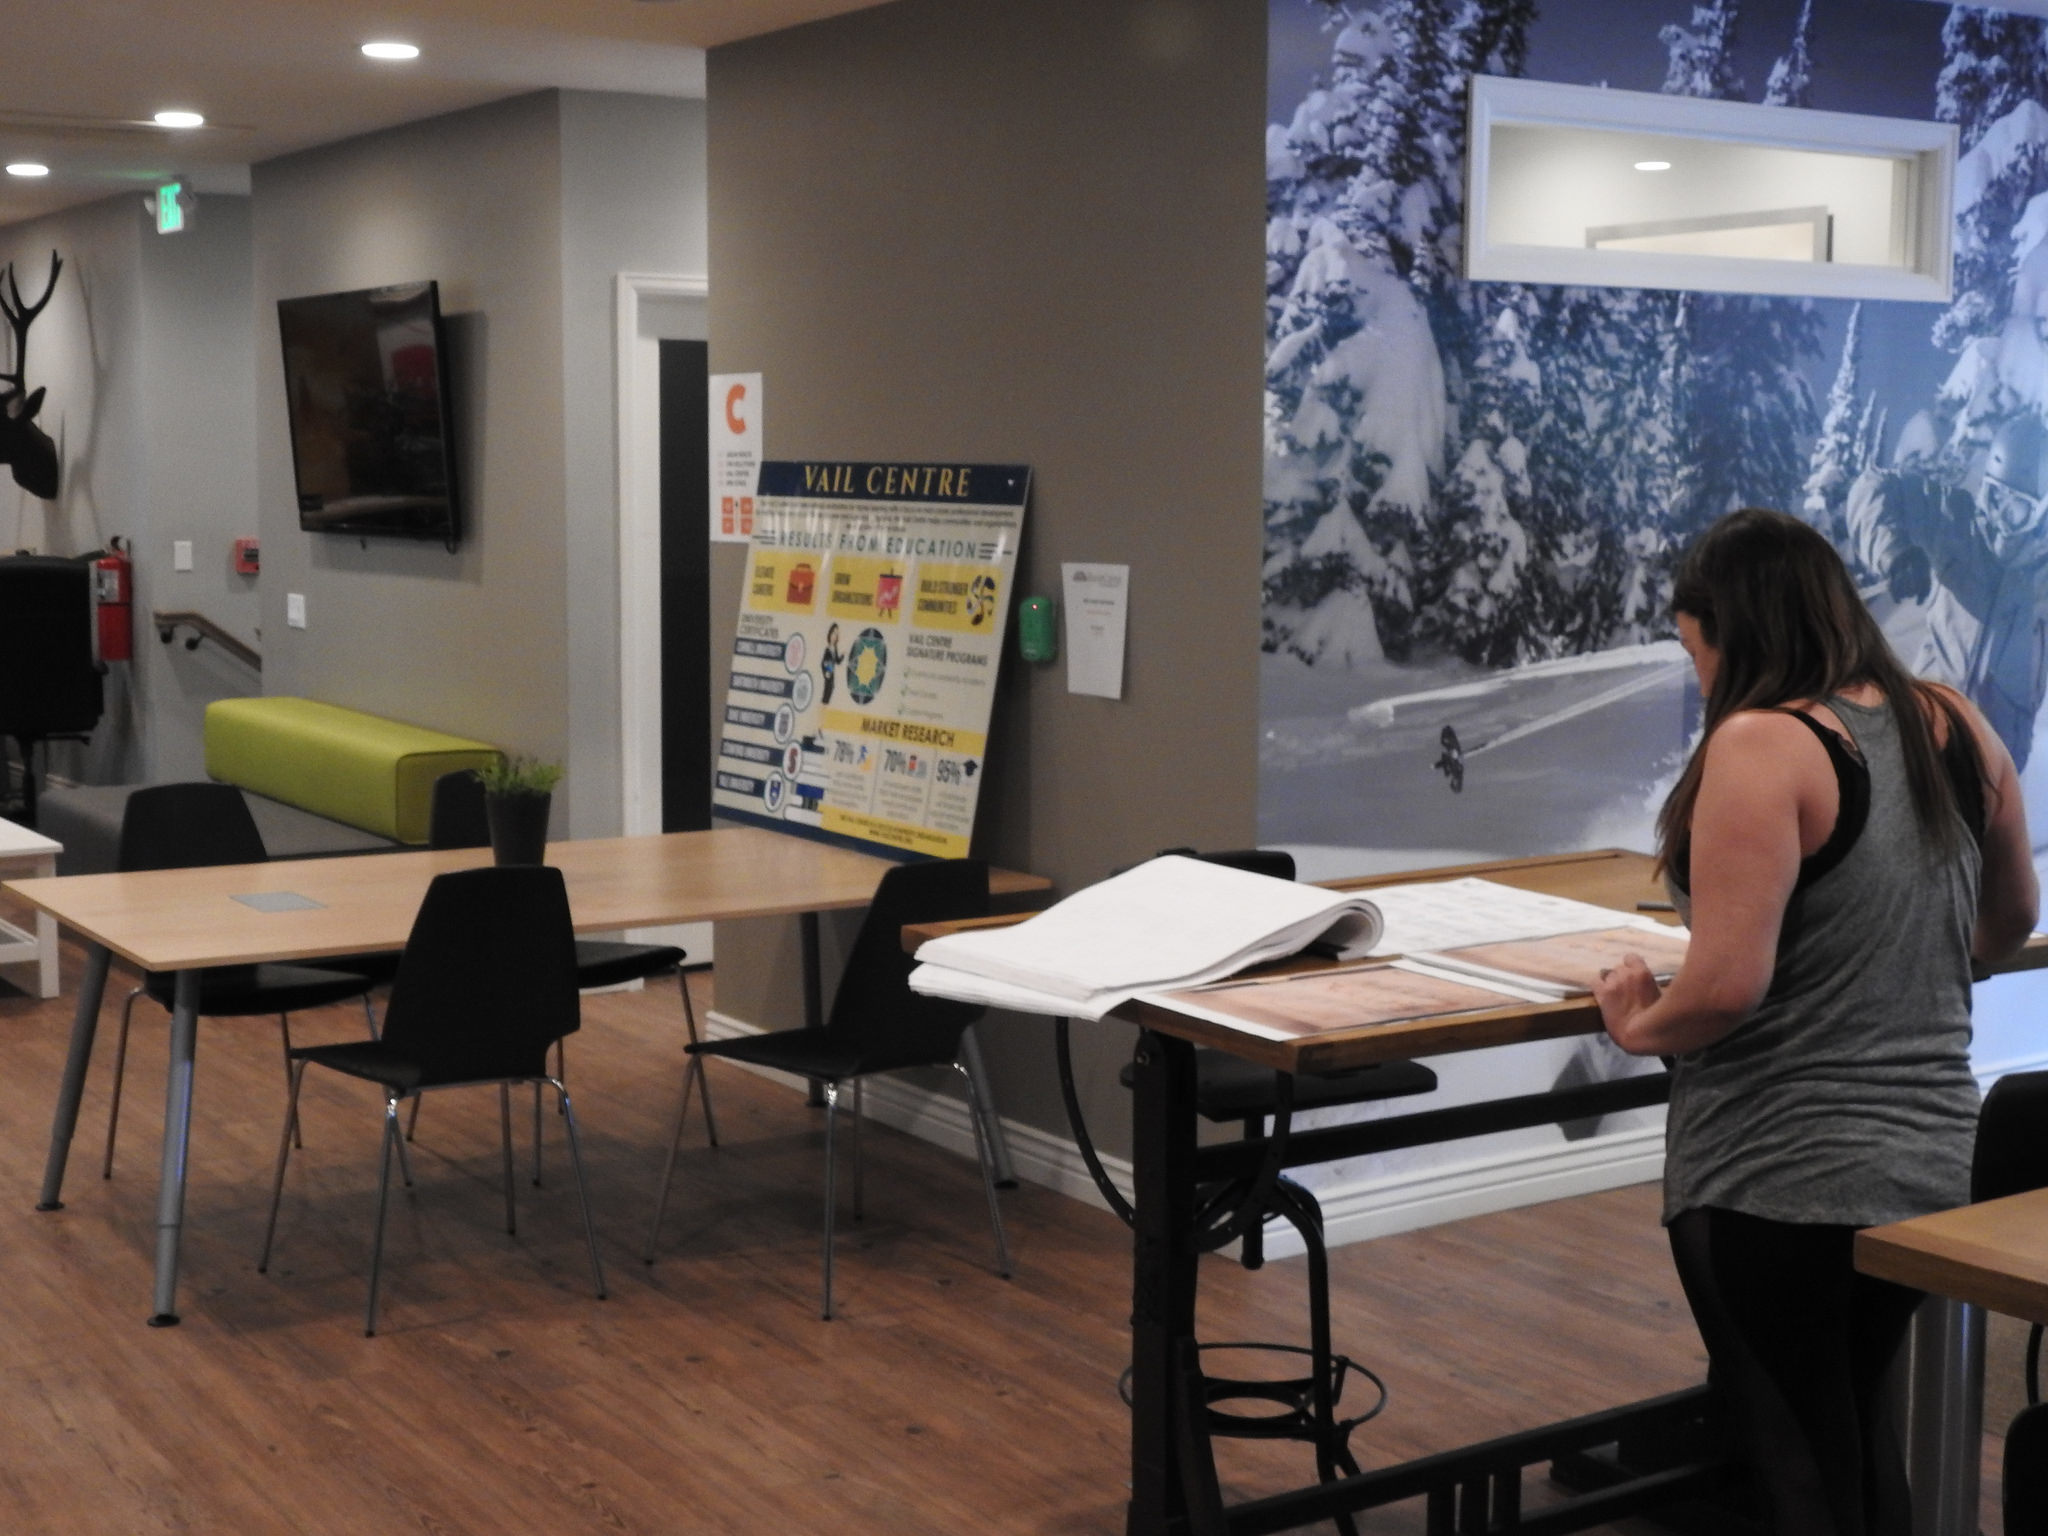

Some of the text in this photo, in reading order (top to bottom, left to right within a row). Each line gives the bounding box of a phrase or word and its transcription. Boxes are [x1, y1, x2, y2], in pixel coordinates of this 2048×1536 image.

[804, 464, 972, 497] VAIL CENTRE
[779, 529, 977, 559] RESULTS FROM EDUCATION
[861, 718, 955, 748] MARKET RESEARCH
